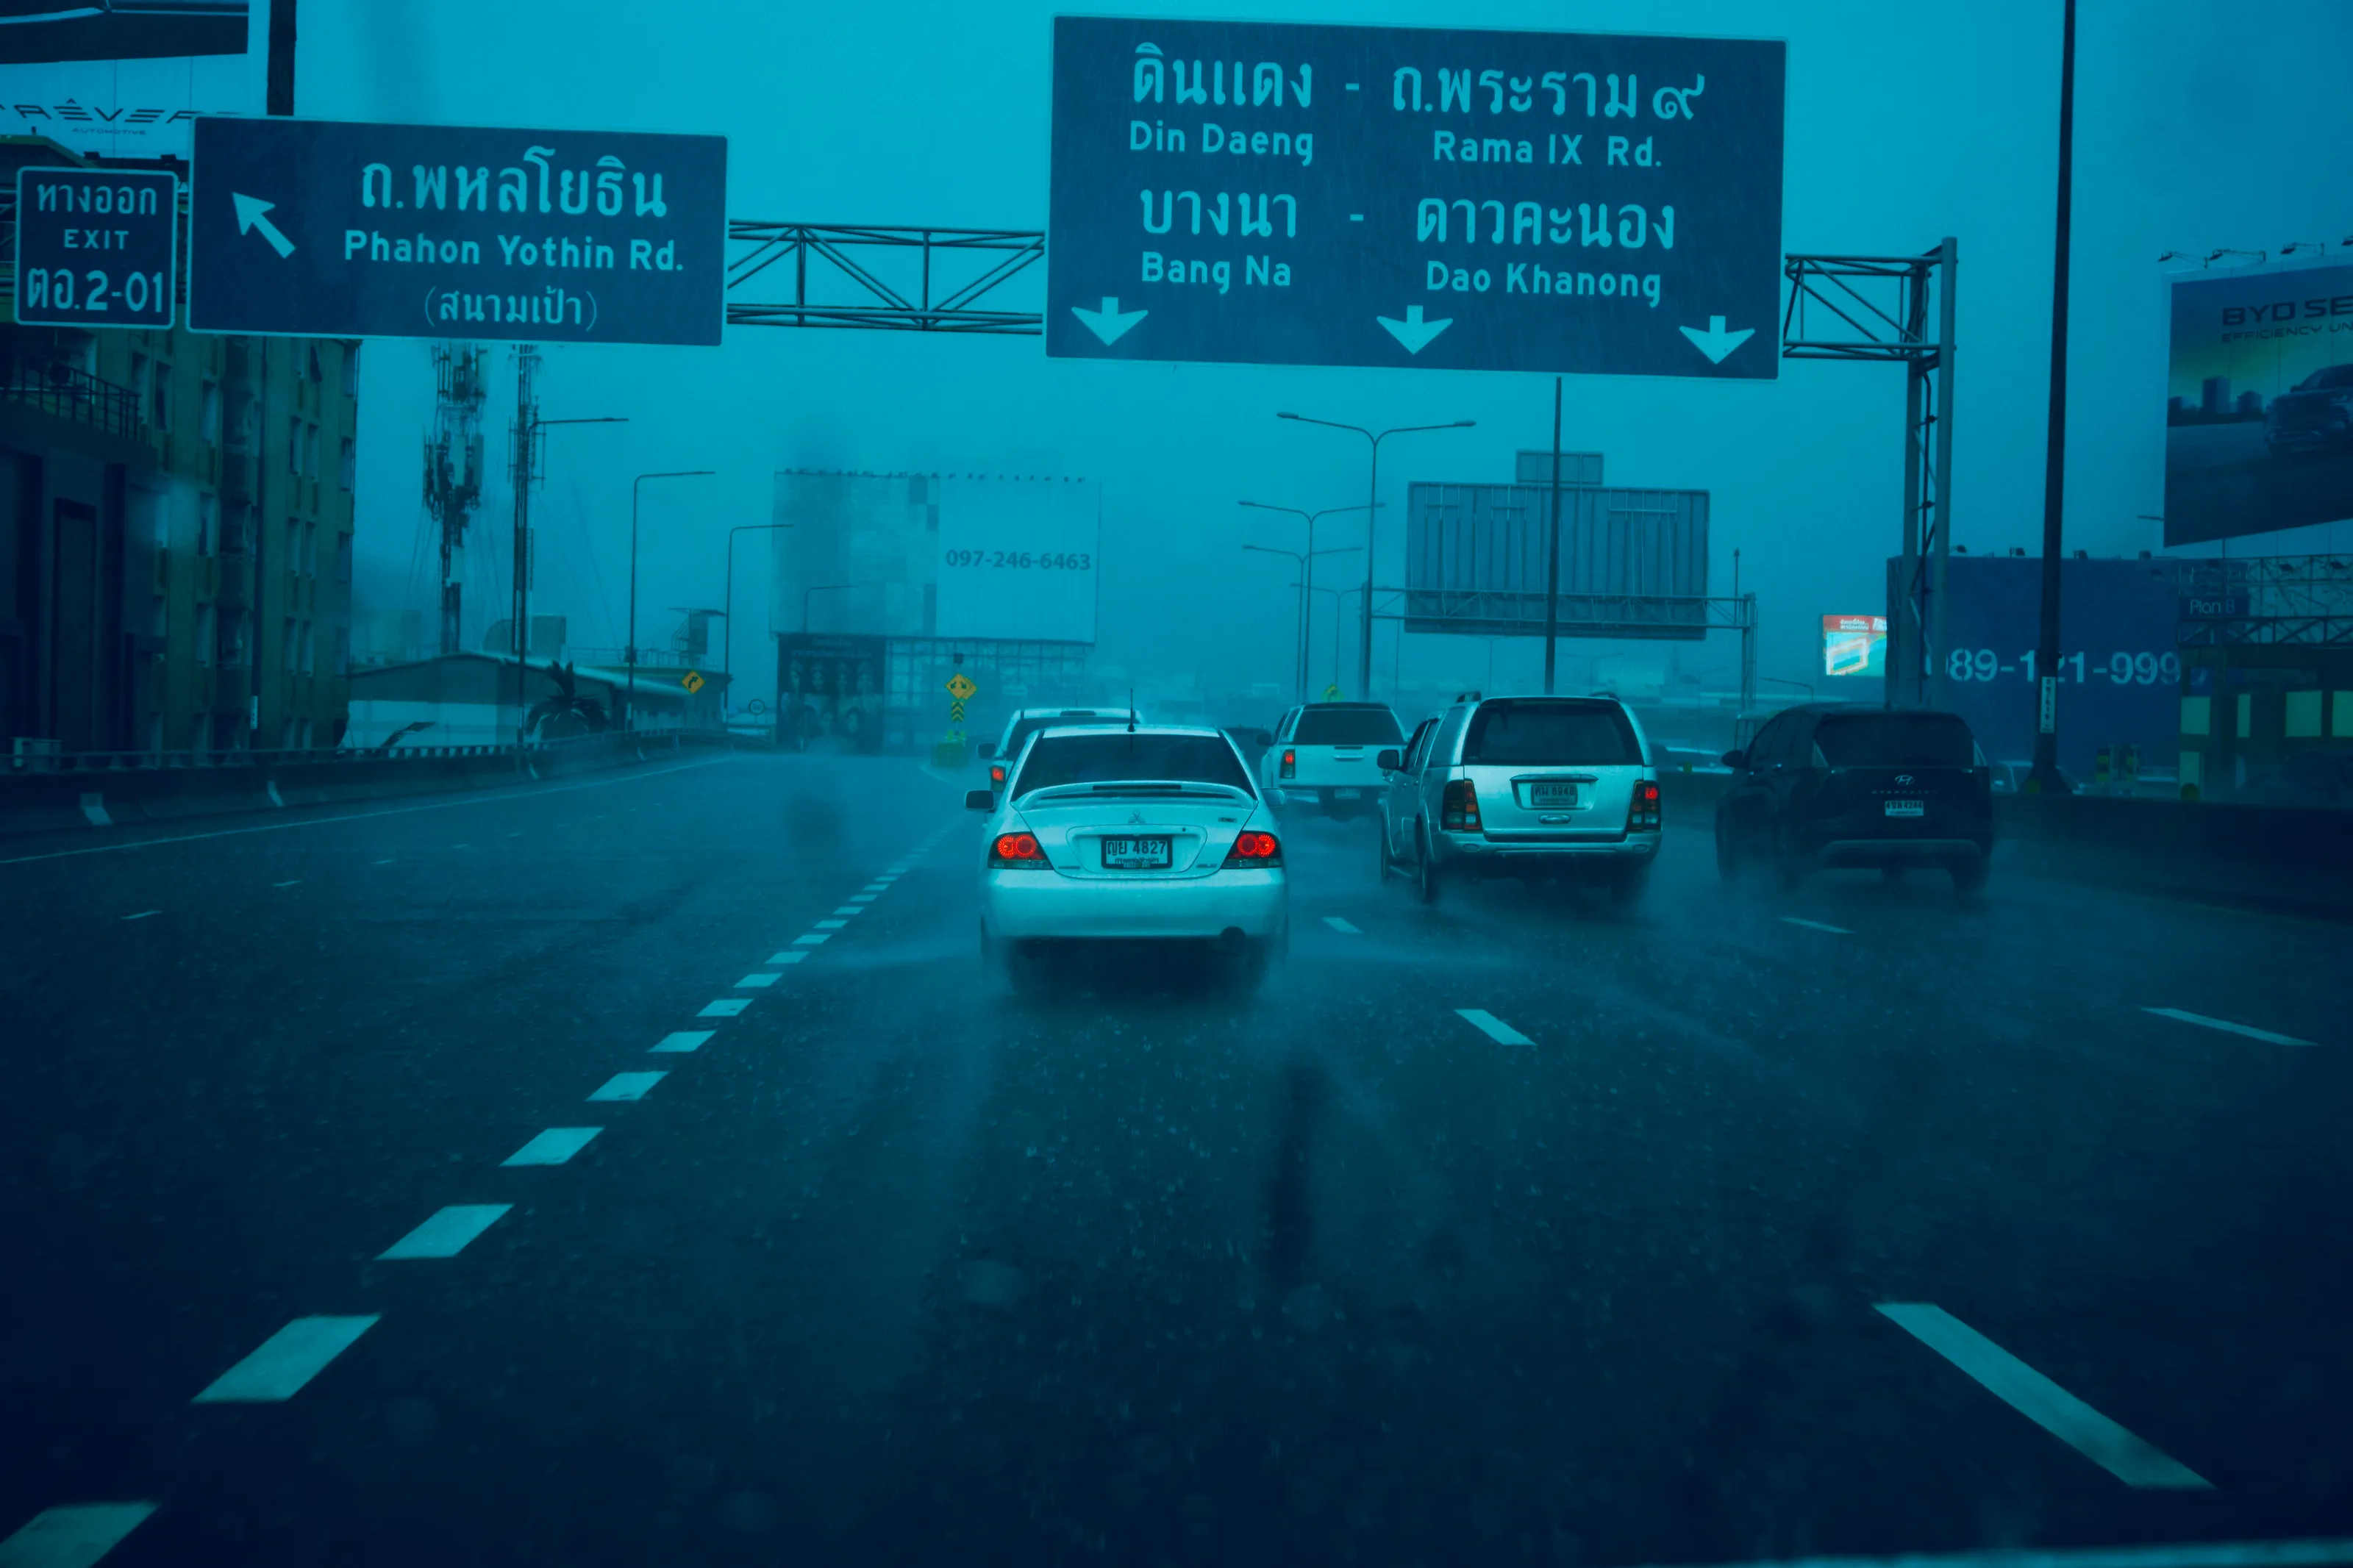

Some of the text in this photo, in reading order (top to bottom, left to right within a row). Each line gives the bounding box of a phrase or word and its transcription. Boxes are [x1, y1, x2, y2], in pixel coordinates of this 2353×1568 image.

[1133, 42, 1313, 108] ดินแดง
[1129, 119, 1313, 167] Din Daeng
[1434, 129, 1662, 167] Rama IX Rd.
[37, 184, 157, 215] ทางออก
[363, 145, 668, 218] ถ.พหลโยธิน
[64, 229, 129, 250] EXIT
[1140, 189, 1296, 238] บางนา
[1416, 197, 1675, 250] ดาวคะนอง
[345, 229, 683, 271] Phahon Yothin Rd.
[27, 268, 163, 313] ตอ.2-01
[1141, 251, 1291, 296] Bang Na
[1427, 260, 1661, 309] Dao Khanong
[2223, 301, 2296, 326] BYD
[2221, 325, 2322, 343] EFFICIENCY
[945, 549, 1091, 571] 097-246-6463
[2190, 598, 2235, 615] Plan B
[1107, 840, 1166, 856] ญย 4827
